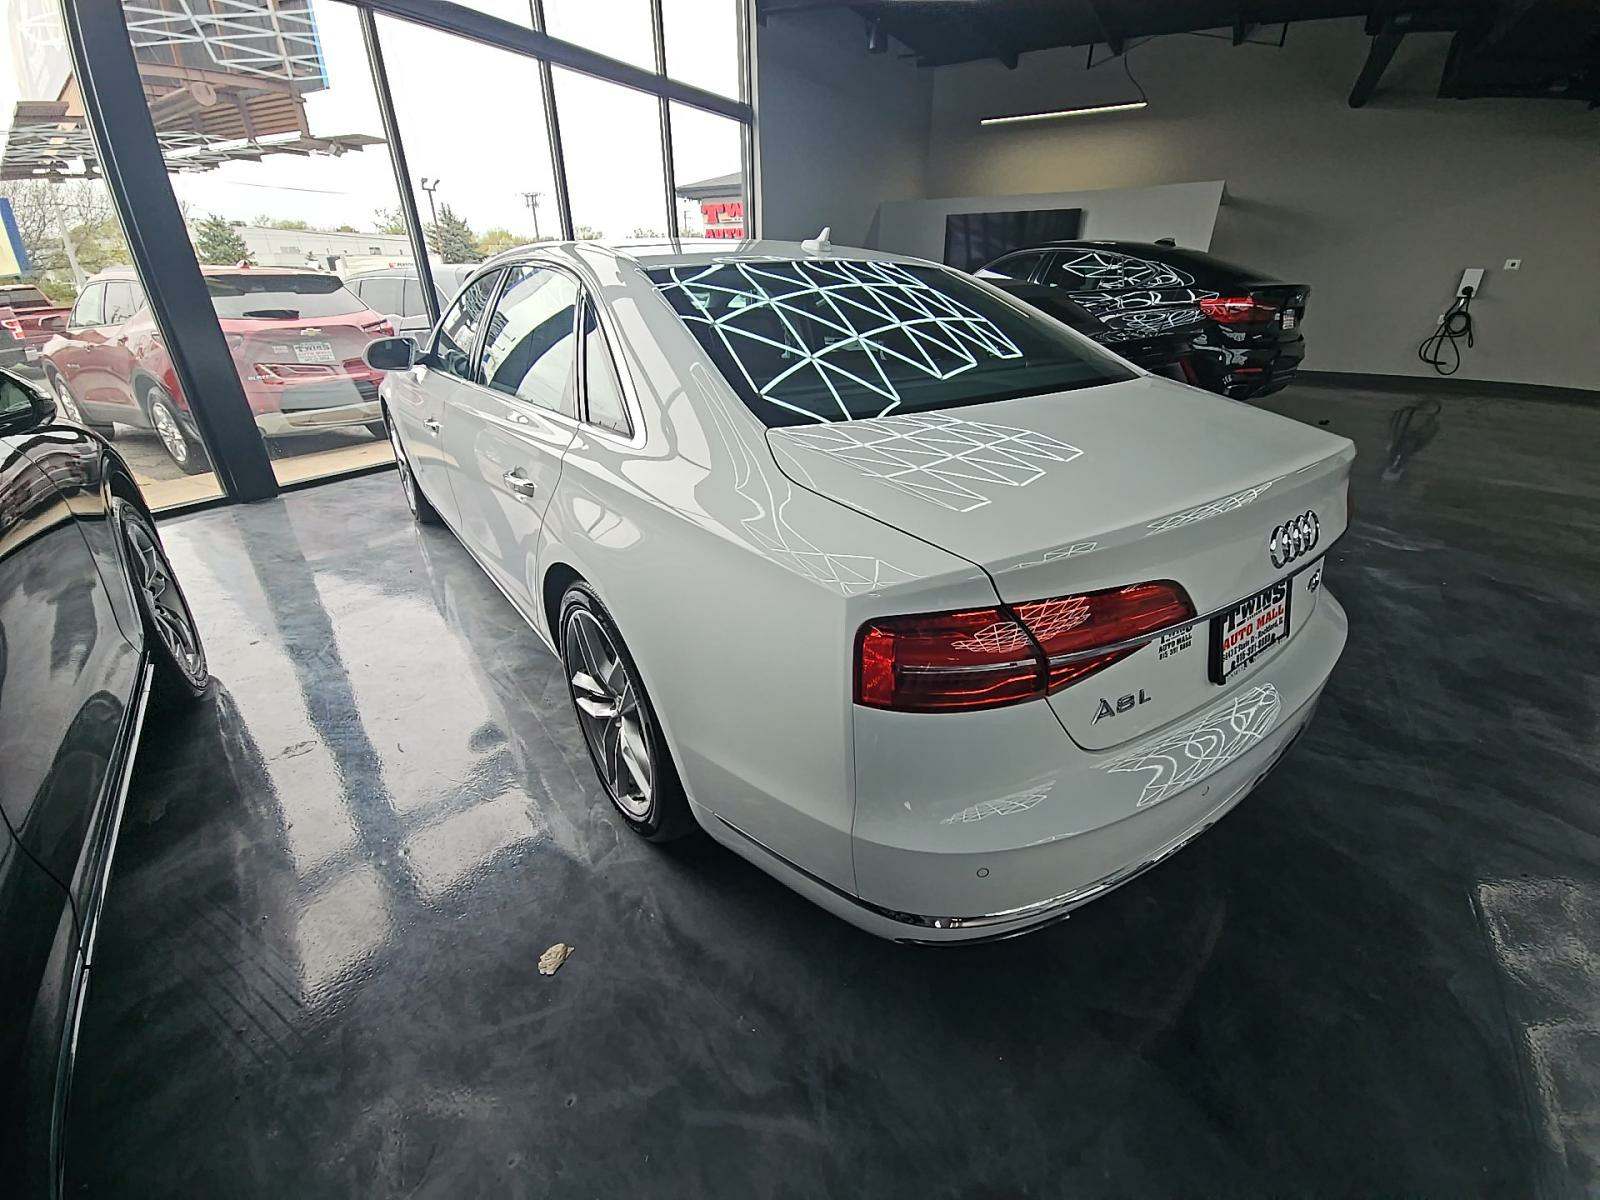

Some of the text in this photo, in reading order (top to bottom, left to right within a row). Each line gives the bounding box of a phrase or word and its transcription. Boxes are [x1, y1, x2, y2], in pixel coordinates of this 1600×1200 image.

[705, 228, 744, 239] AUTO
[1223, 580, 1286, 633] TWINS
[1159, 640, 1176, 653] AUTO
[1176, 632, 1193, 646] MALL
[1223, 623, 1253, 651] AUTO
[1256, 604, 1284, 630] MALL
[1091, 689, 1152, 725] A8L
